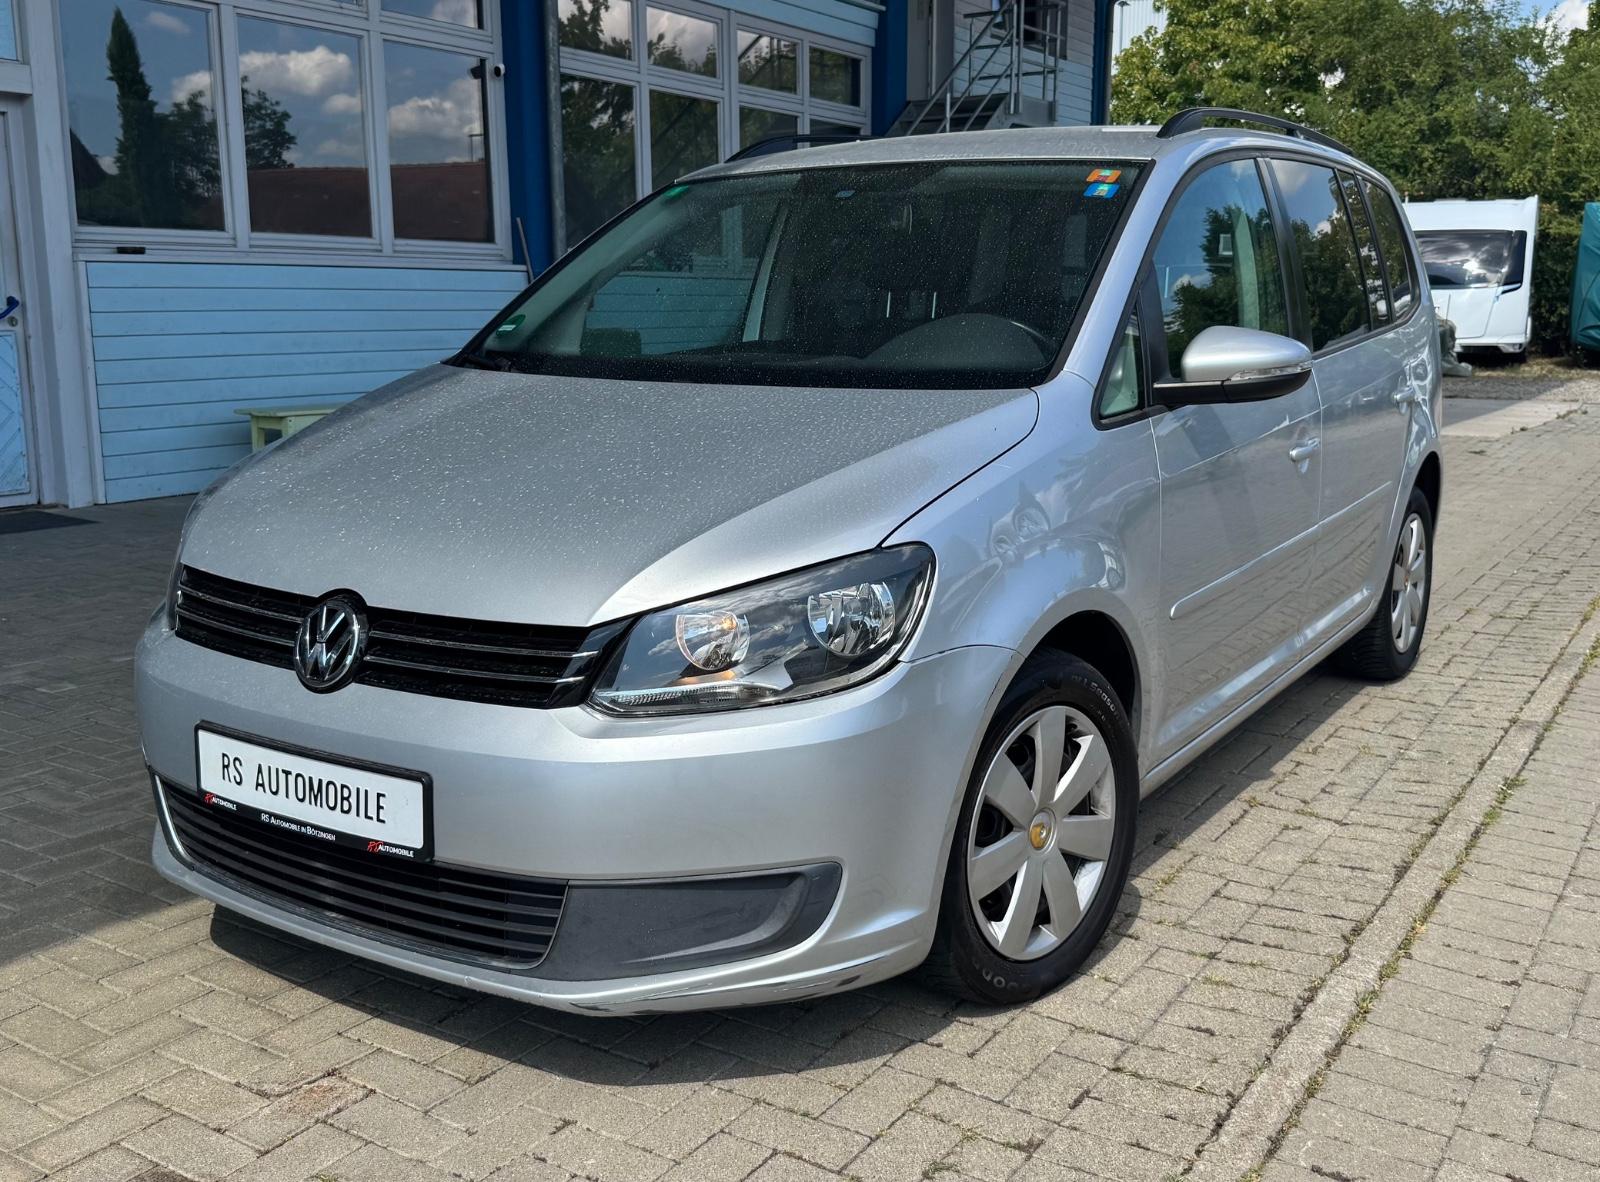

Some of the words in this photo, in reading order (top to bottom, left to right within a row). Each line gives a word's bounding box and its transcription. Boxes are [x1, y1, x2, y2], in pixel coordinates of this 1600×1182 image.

[302, 604, 354, 681] VW
[221, 752, 243, 786] RS
[255, 763, 387, 824] AUTOMOBILE
[261, 812, 270, 823] RS
